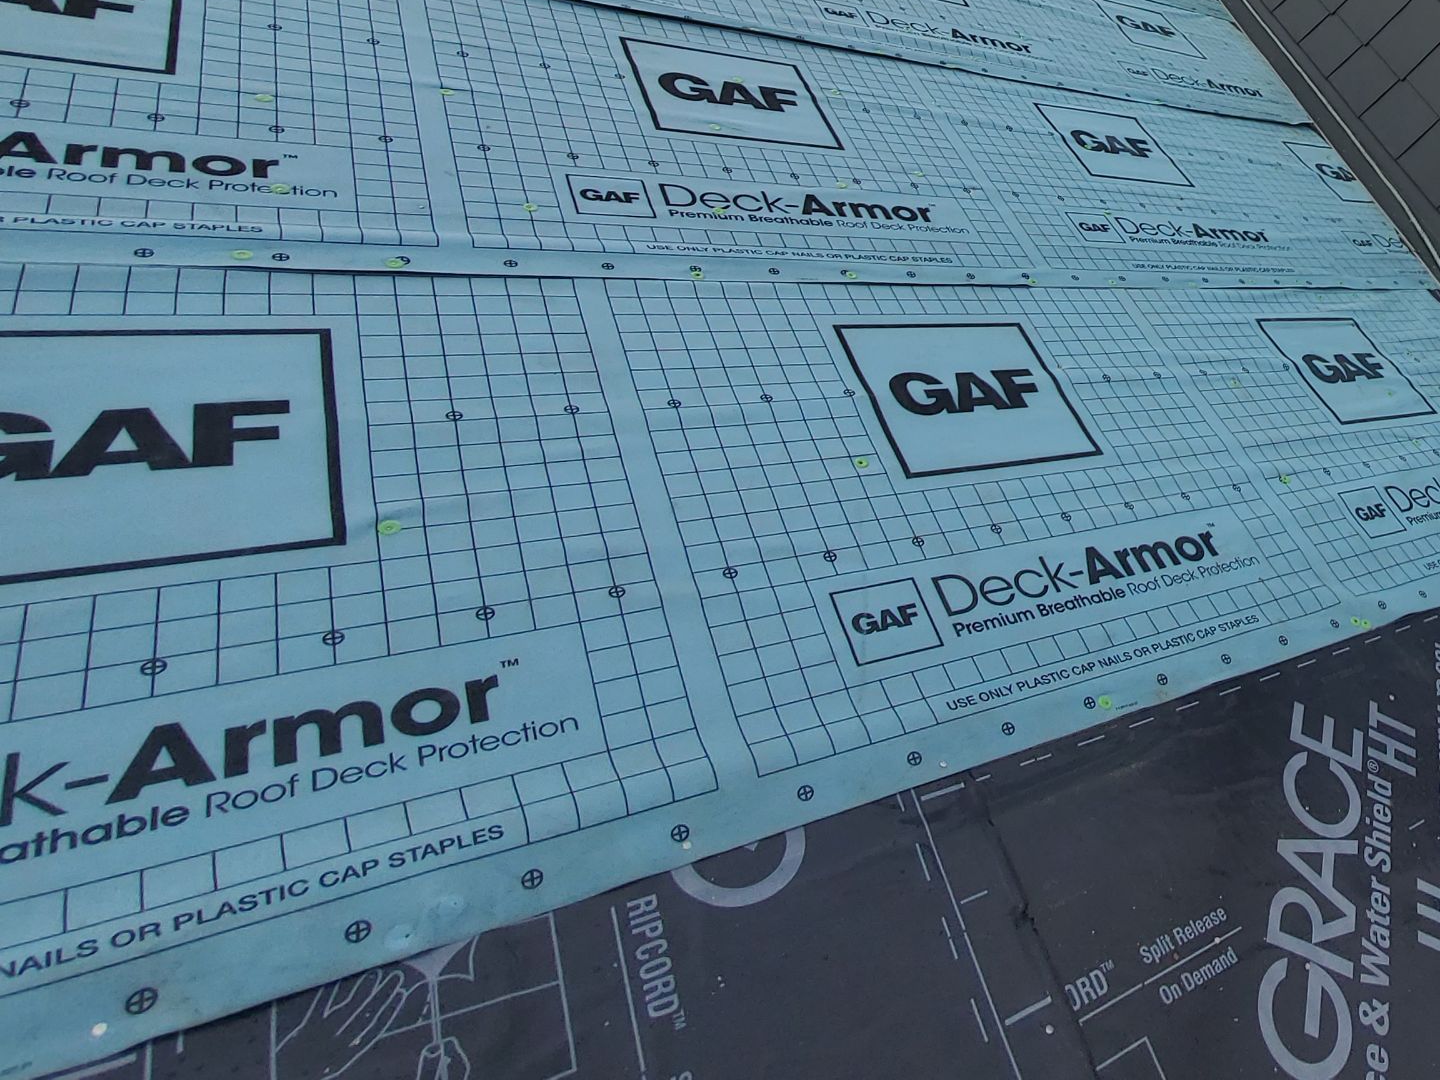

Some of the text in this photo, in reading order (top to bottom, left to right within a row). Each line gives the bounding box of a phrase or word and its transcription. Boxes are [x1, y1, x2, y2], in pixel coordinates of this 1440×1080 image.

[824, 7, 858, 19] GAF
[866, 10, 1031, 54] Deck-Armor
[1116, 15, 1175, 38] GAF
[657, 70, 799, 113] GAF
[1151, 68, 1263, 97] Deck-Armor
[1069, 128, 1154, 159] GAF
[46, 168, 118, 184] Roof
[126, 174, 200, 190] Deck
[1315, 163, 1358, 182] GA
[579, 188, 640, 204] GAF
[120, 220, 166, 229] CAP
[173, 222, 264, 234] STAPLES
[668, 209, 970, 235] Premium Breathable Roof Deck Protection
[1078, 221, 1112, 233] GAF
[712, 247, 764, 256] PLASTIC
[791, 251, 825, 259] NAILS
[845, 254, 887, 262] PLASTIC
[911, 256, 953, 264] STAPLES
[1128, 235, 1171, 246] Premium
[1300, 351, 1385, 385] GAF
[888, 368, 1039, 416] GAF
[1354, 503, 1387, 522] GAF
[1423, 560, 1437, 571] USE
[952, 556, 1261, 638] Premium Breathable Roof Deck Protection
[851, 602, 919, 636] GAF
[945, 615, 1260, 711] USE ONLY PLASTIC CAP NAILS OR PLASTIC CAP STAPLES
[1367, 700, 1418, 778] HT
[204, 773, 301, 819] Roof
[309, 751, 408, 794] Deck
[416, 715, 581, 769] Protection
[109, 920, 163, 950] OR
[173, 878, 310, 933] PLASTIC
[318, 858, 380, 889] CAP
[387, 823, 506, 871] STAPLES
[1257, 701, 1364, 1080] GRACE
[1140, 907, 1227, 963] Split Release
[1359, 875, 1391, 987] Water
[1159, 946, 1239, 1005] On Demand
[1358, 1000, 1391, 1036] &
